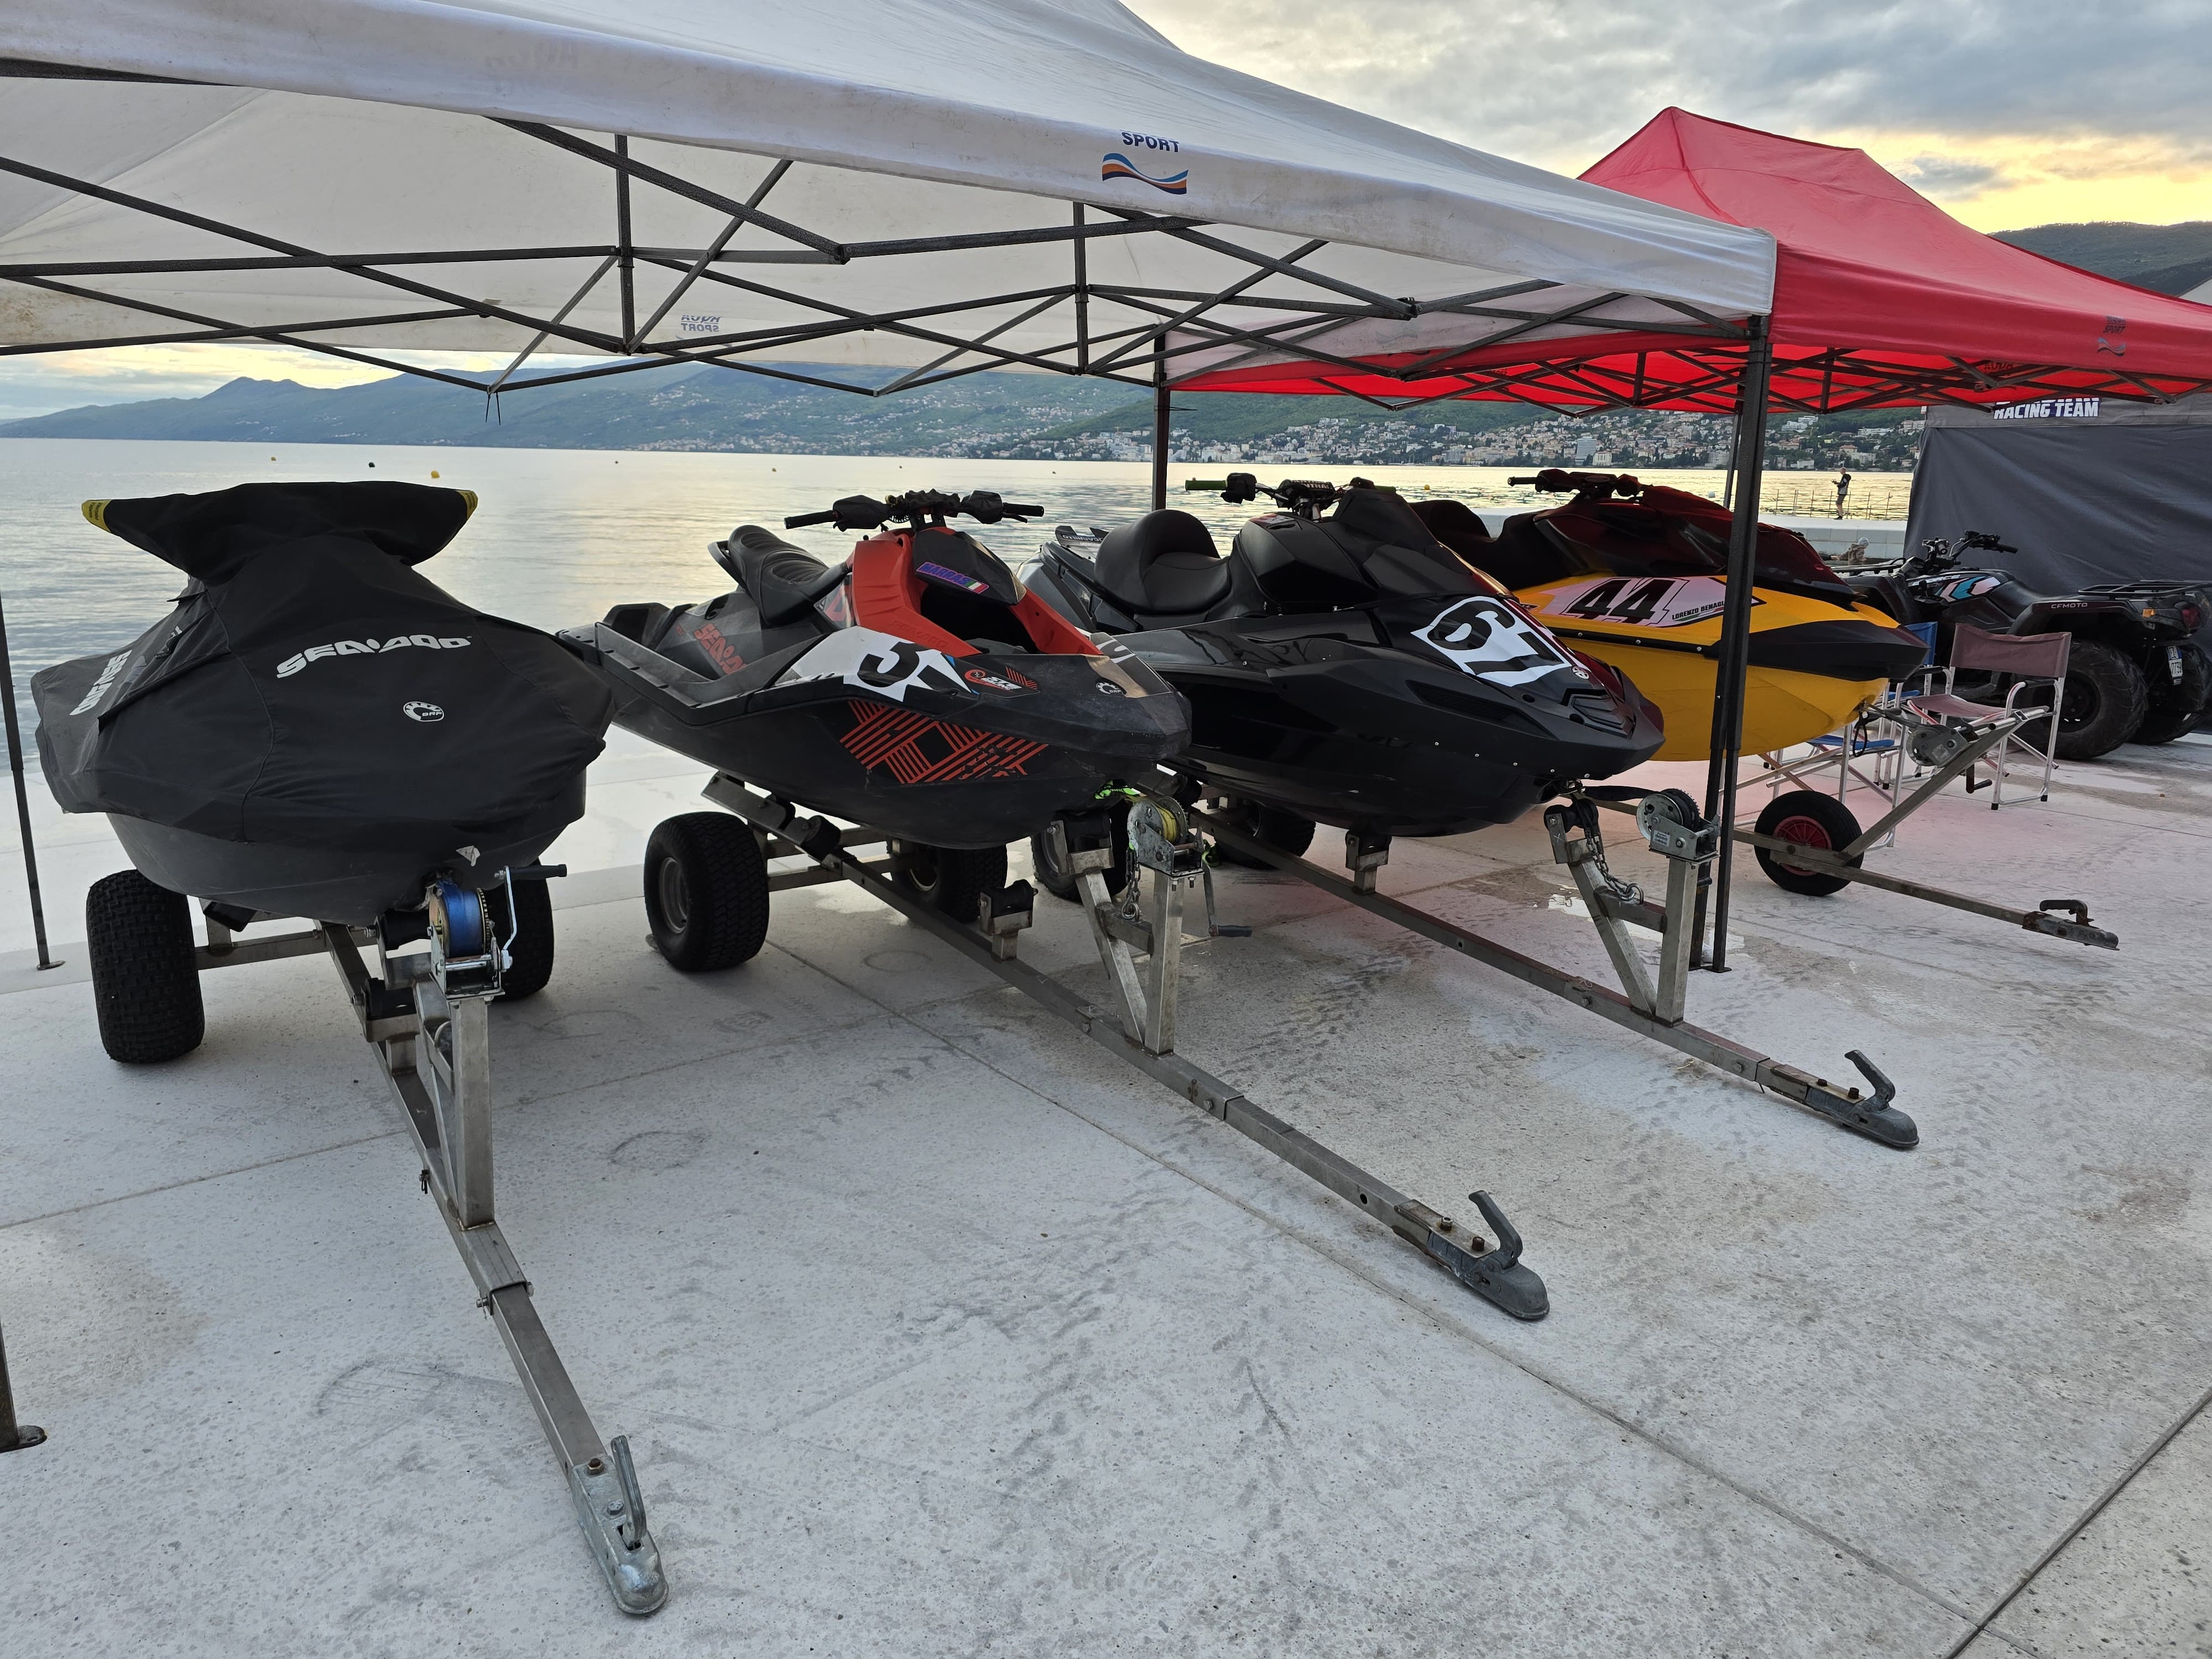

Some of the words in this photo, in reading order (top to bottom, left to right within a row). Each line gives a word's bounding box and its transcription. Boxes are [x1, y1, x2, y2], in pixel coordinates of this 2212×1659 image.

[1121, 132, 1180, 153] SPORT
[2103, 325, 2126, 334] SPORT
[1994, 403, 2051, 419] RACING
[2055, 401, 2099, 416] TEAM
[1567, 579, 1676, 624] 44
[1672, 608, 1699, 620] LORENZO
[1701, 601, 1725, 612] BENAGL
[1427, 601, 1564, 676] 67
